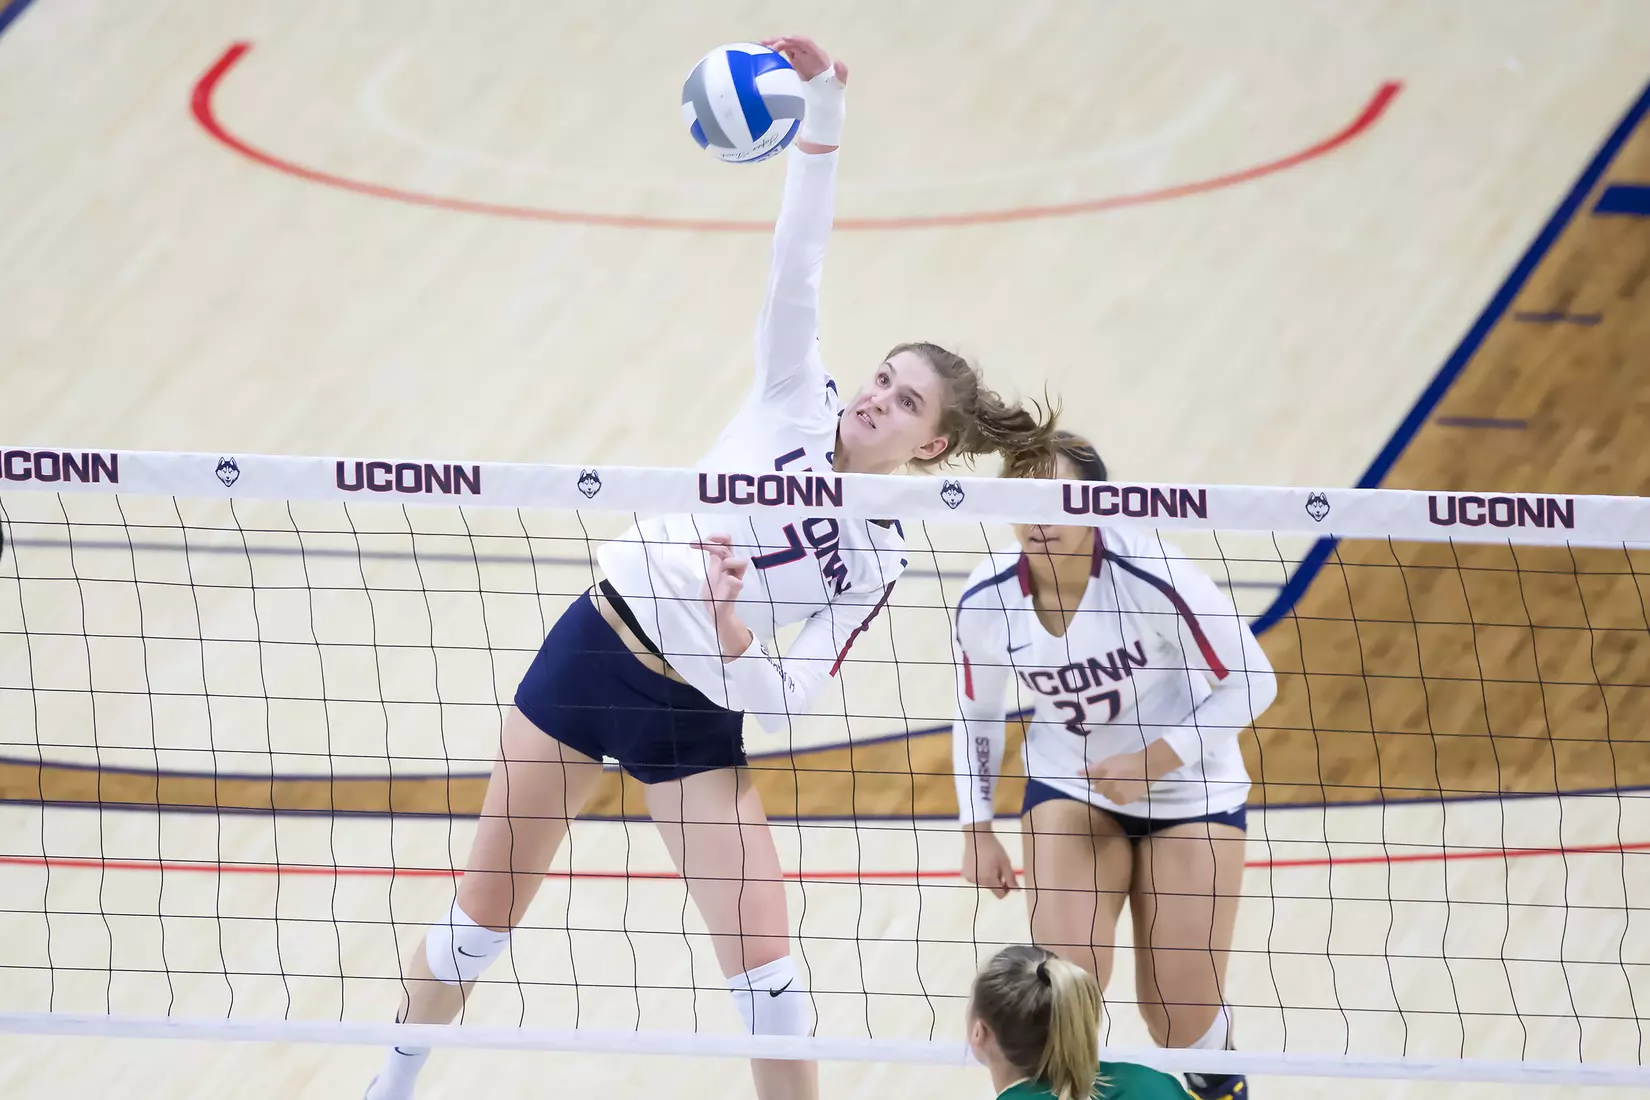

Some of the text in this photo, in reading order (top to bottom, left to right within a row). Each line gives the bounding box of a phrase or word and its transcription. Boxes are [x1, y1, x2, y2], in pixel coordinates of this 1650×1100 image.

[0, 450, 1576, 529] CONN UCONN UCONN UCONN UCONN
[750, 522, 807, 570] 7
[1053, 688, 1121, 737] 27
[975, 736, 992, 801] HUSKIES
